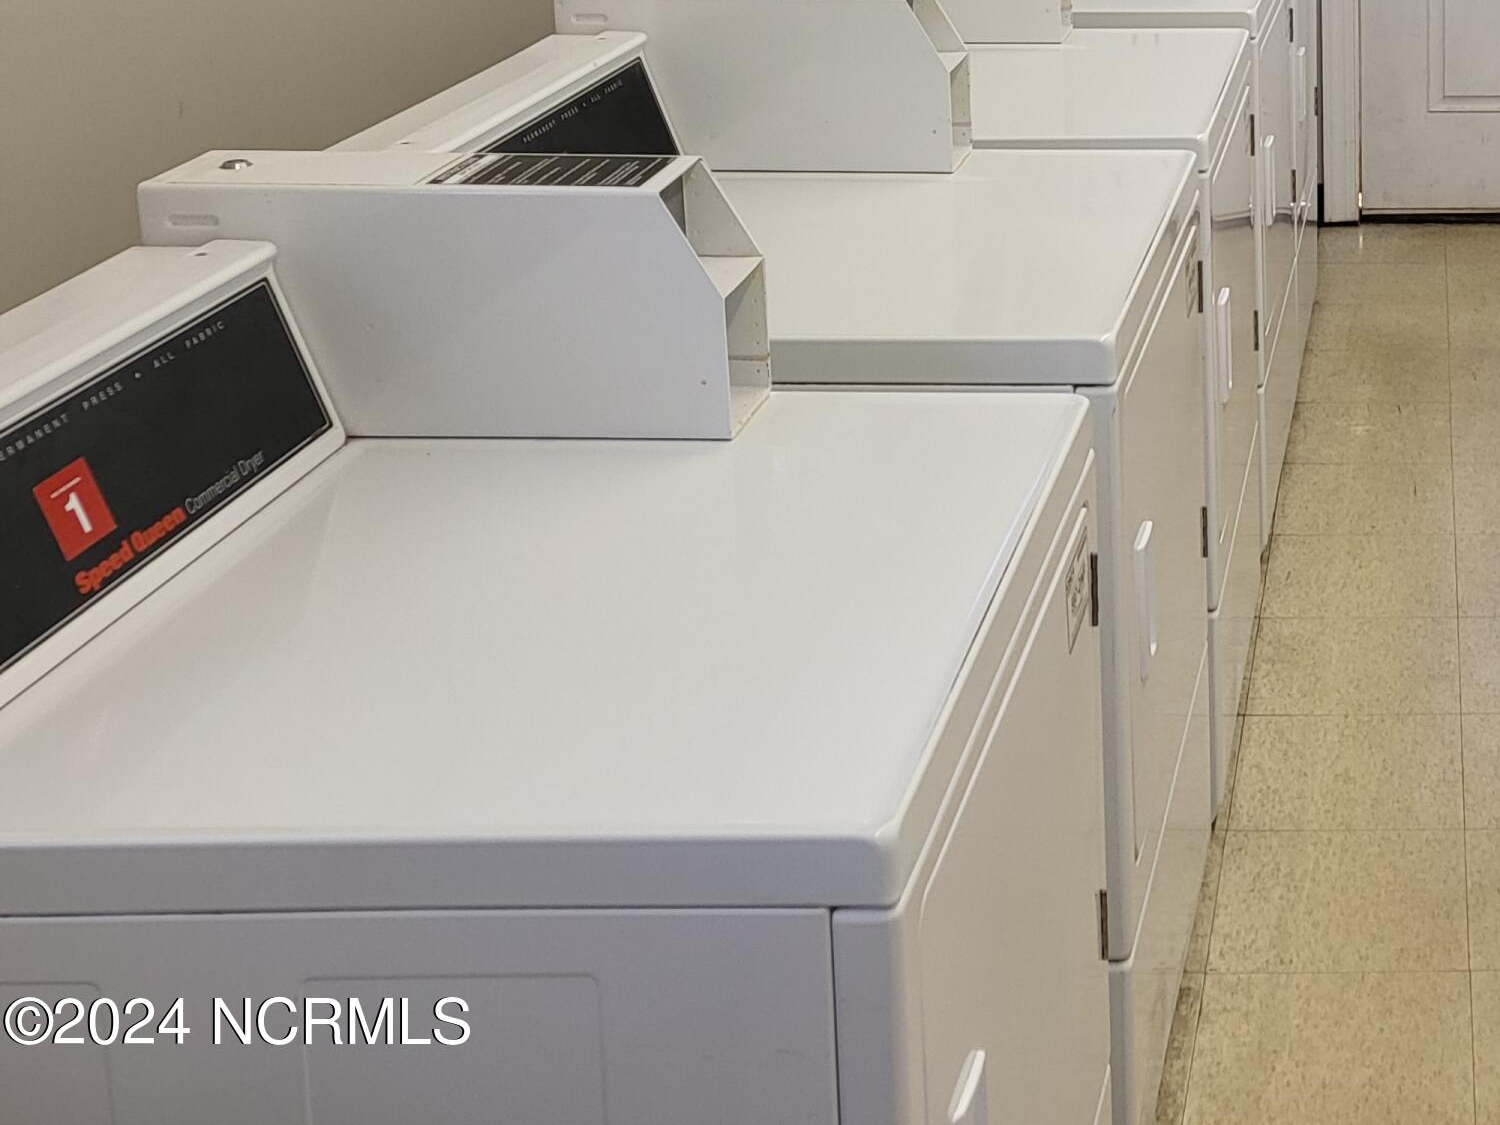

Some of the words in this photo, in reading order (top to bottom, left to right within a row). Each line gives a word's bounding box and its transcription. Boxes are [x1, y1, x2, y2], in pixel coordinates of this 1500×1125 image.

[0, 412, 69, 462] ERMANENT
[82, 381, 124, 411] PRESS
[152, 350, 176, 369] ALL
[184, 319, 226, 351] FABRIC
[63, 491, 93, 534] 1
[74, 542, 132, 595] Speed
[130, 507, 187, 554] Queen
[184, 467, 240, 515] Commercial
[237, 448, 267, 481] Dryer
